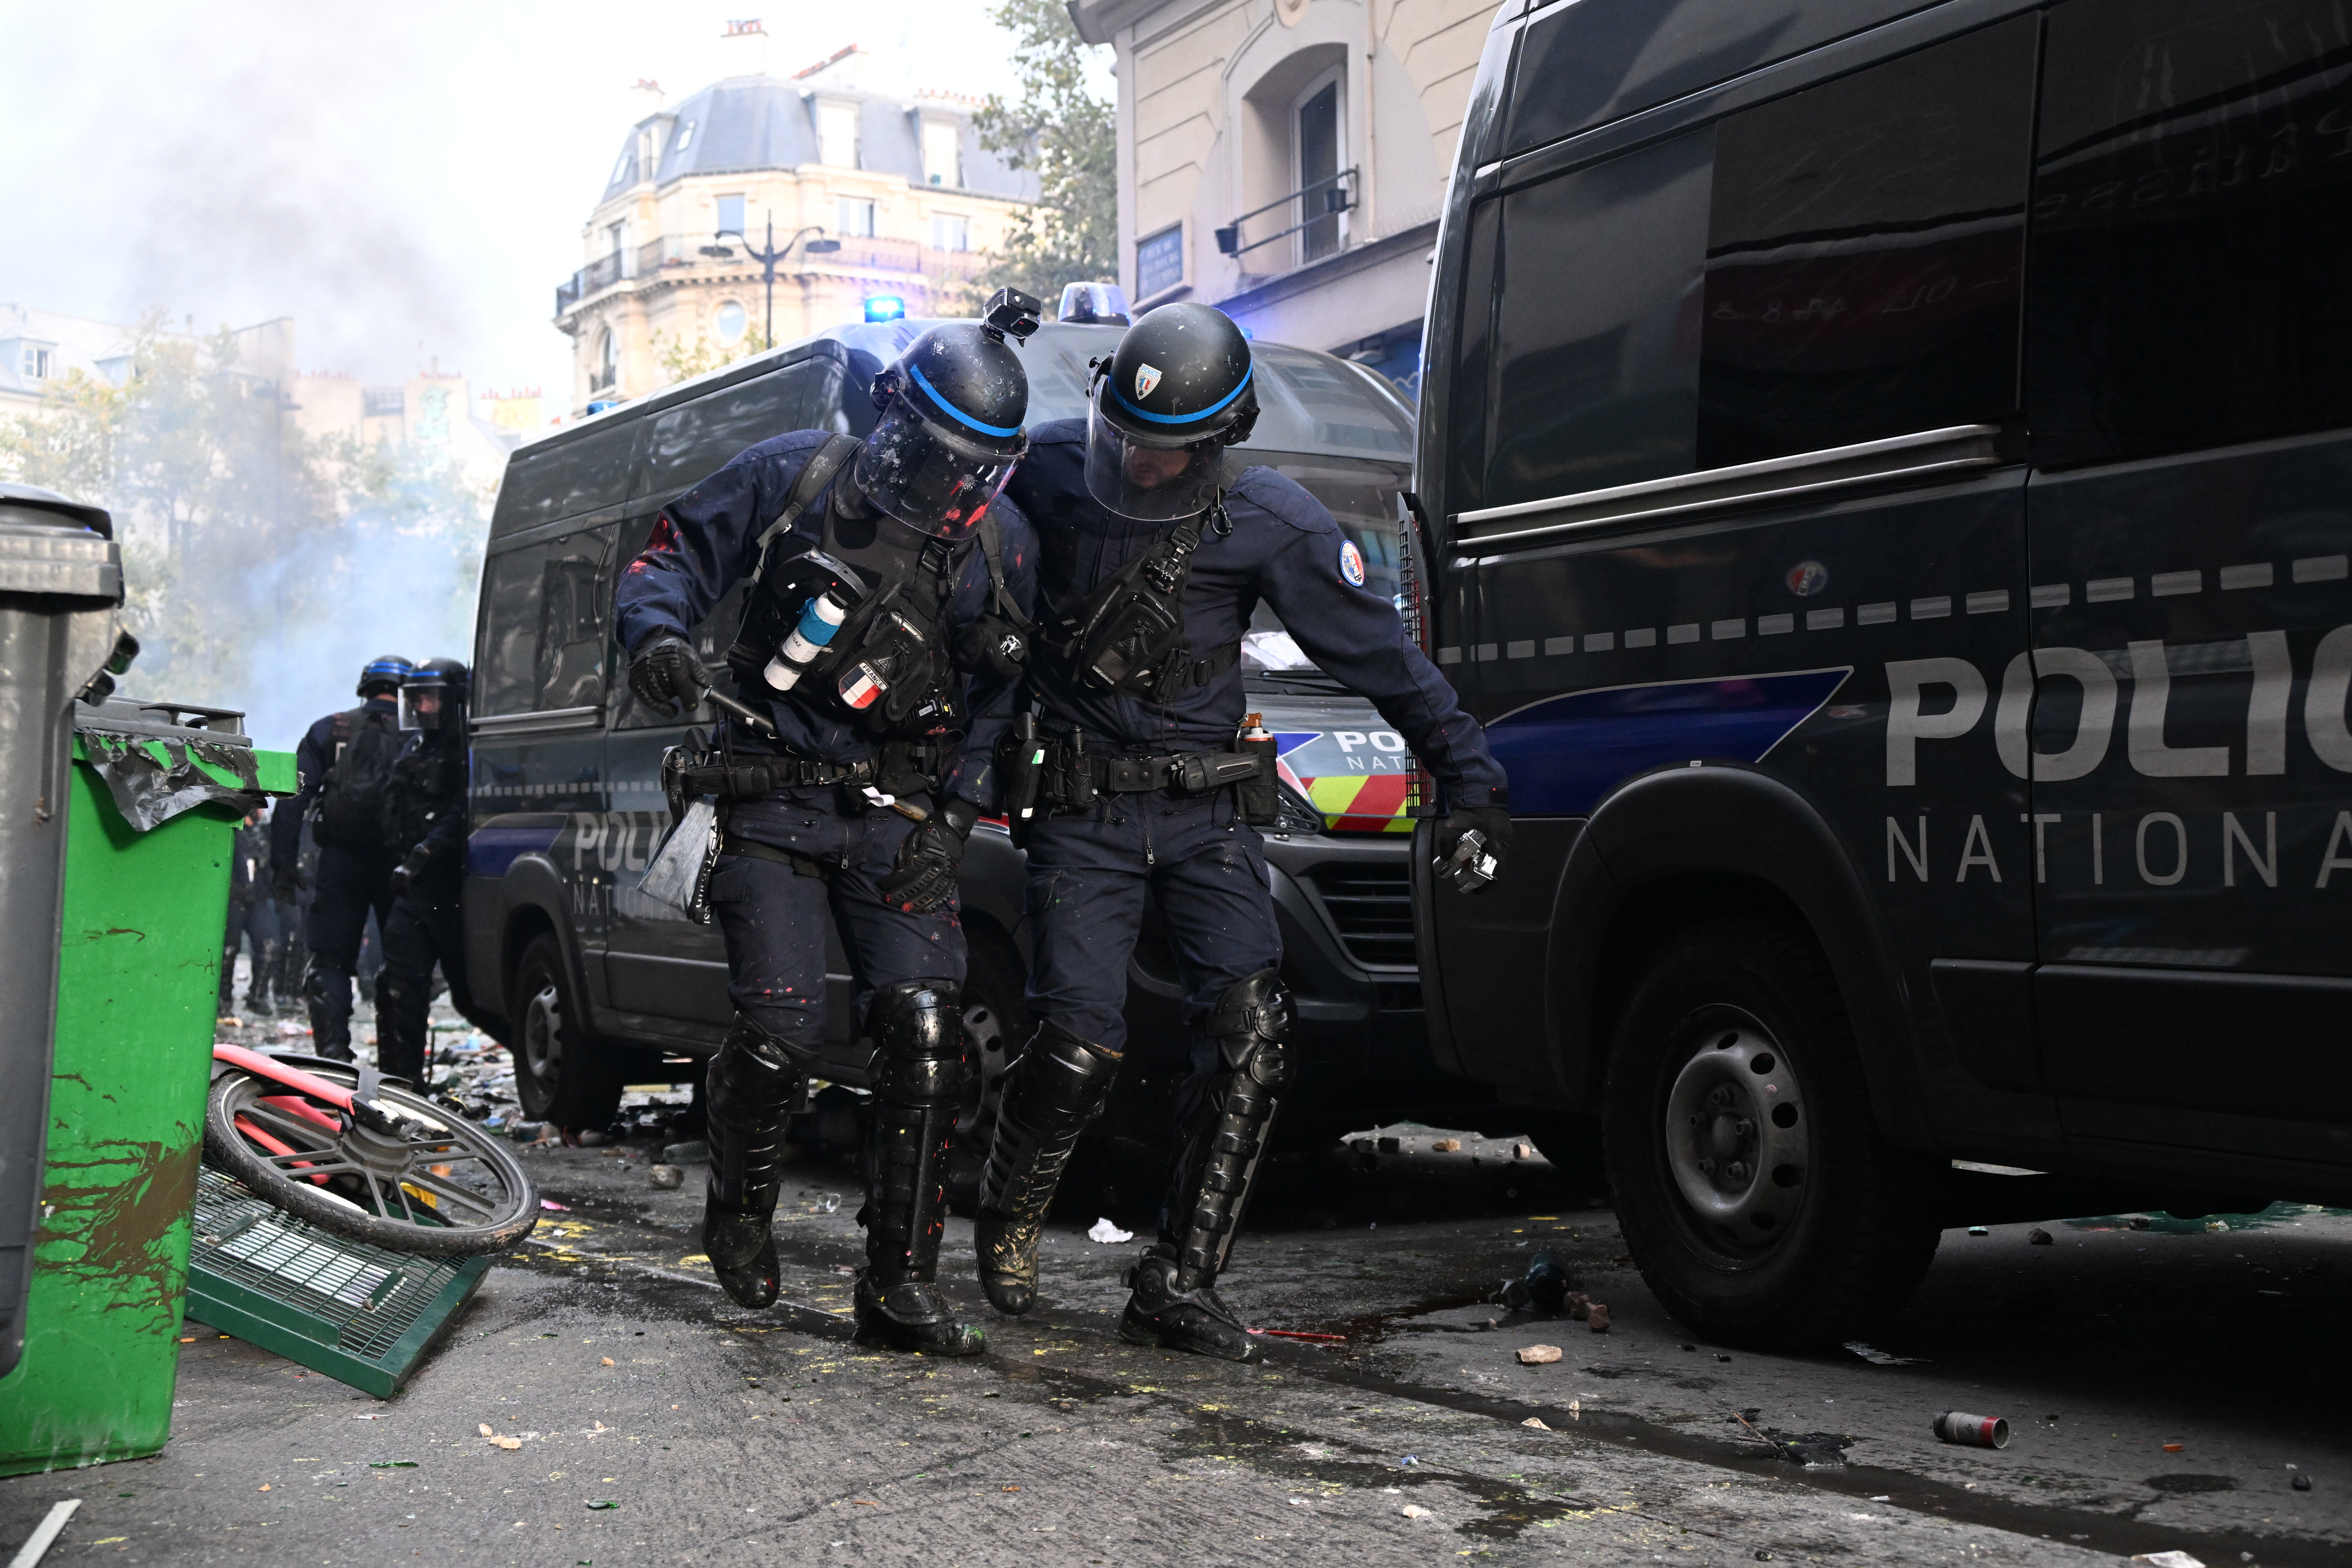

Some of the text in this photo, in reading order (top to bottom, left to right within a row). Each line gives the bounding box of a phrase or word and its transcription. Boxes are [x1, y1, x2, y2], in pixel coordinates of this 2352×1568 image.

[1141, 366, 1159, 378] POLICE
[793, 637, 801, 648] GAZ
[873, 659, 886, 674] DIMATE
[862, 665, 884, 688] FRANCE
[1333, 731, 1406, 752] PO
[1886, 811, 2352, 889] NATIONA
